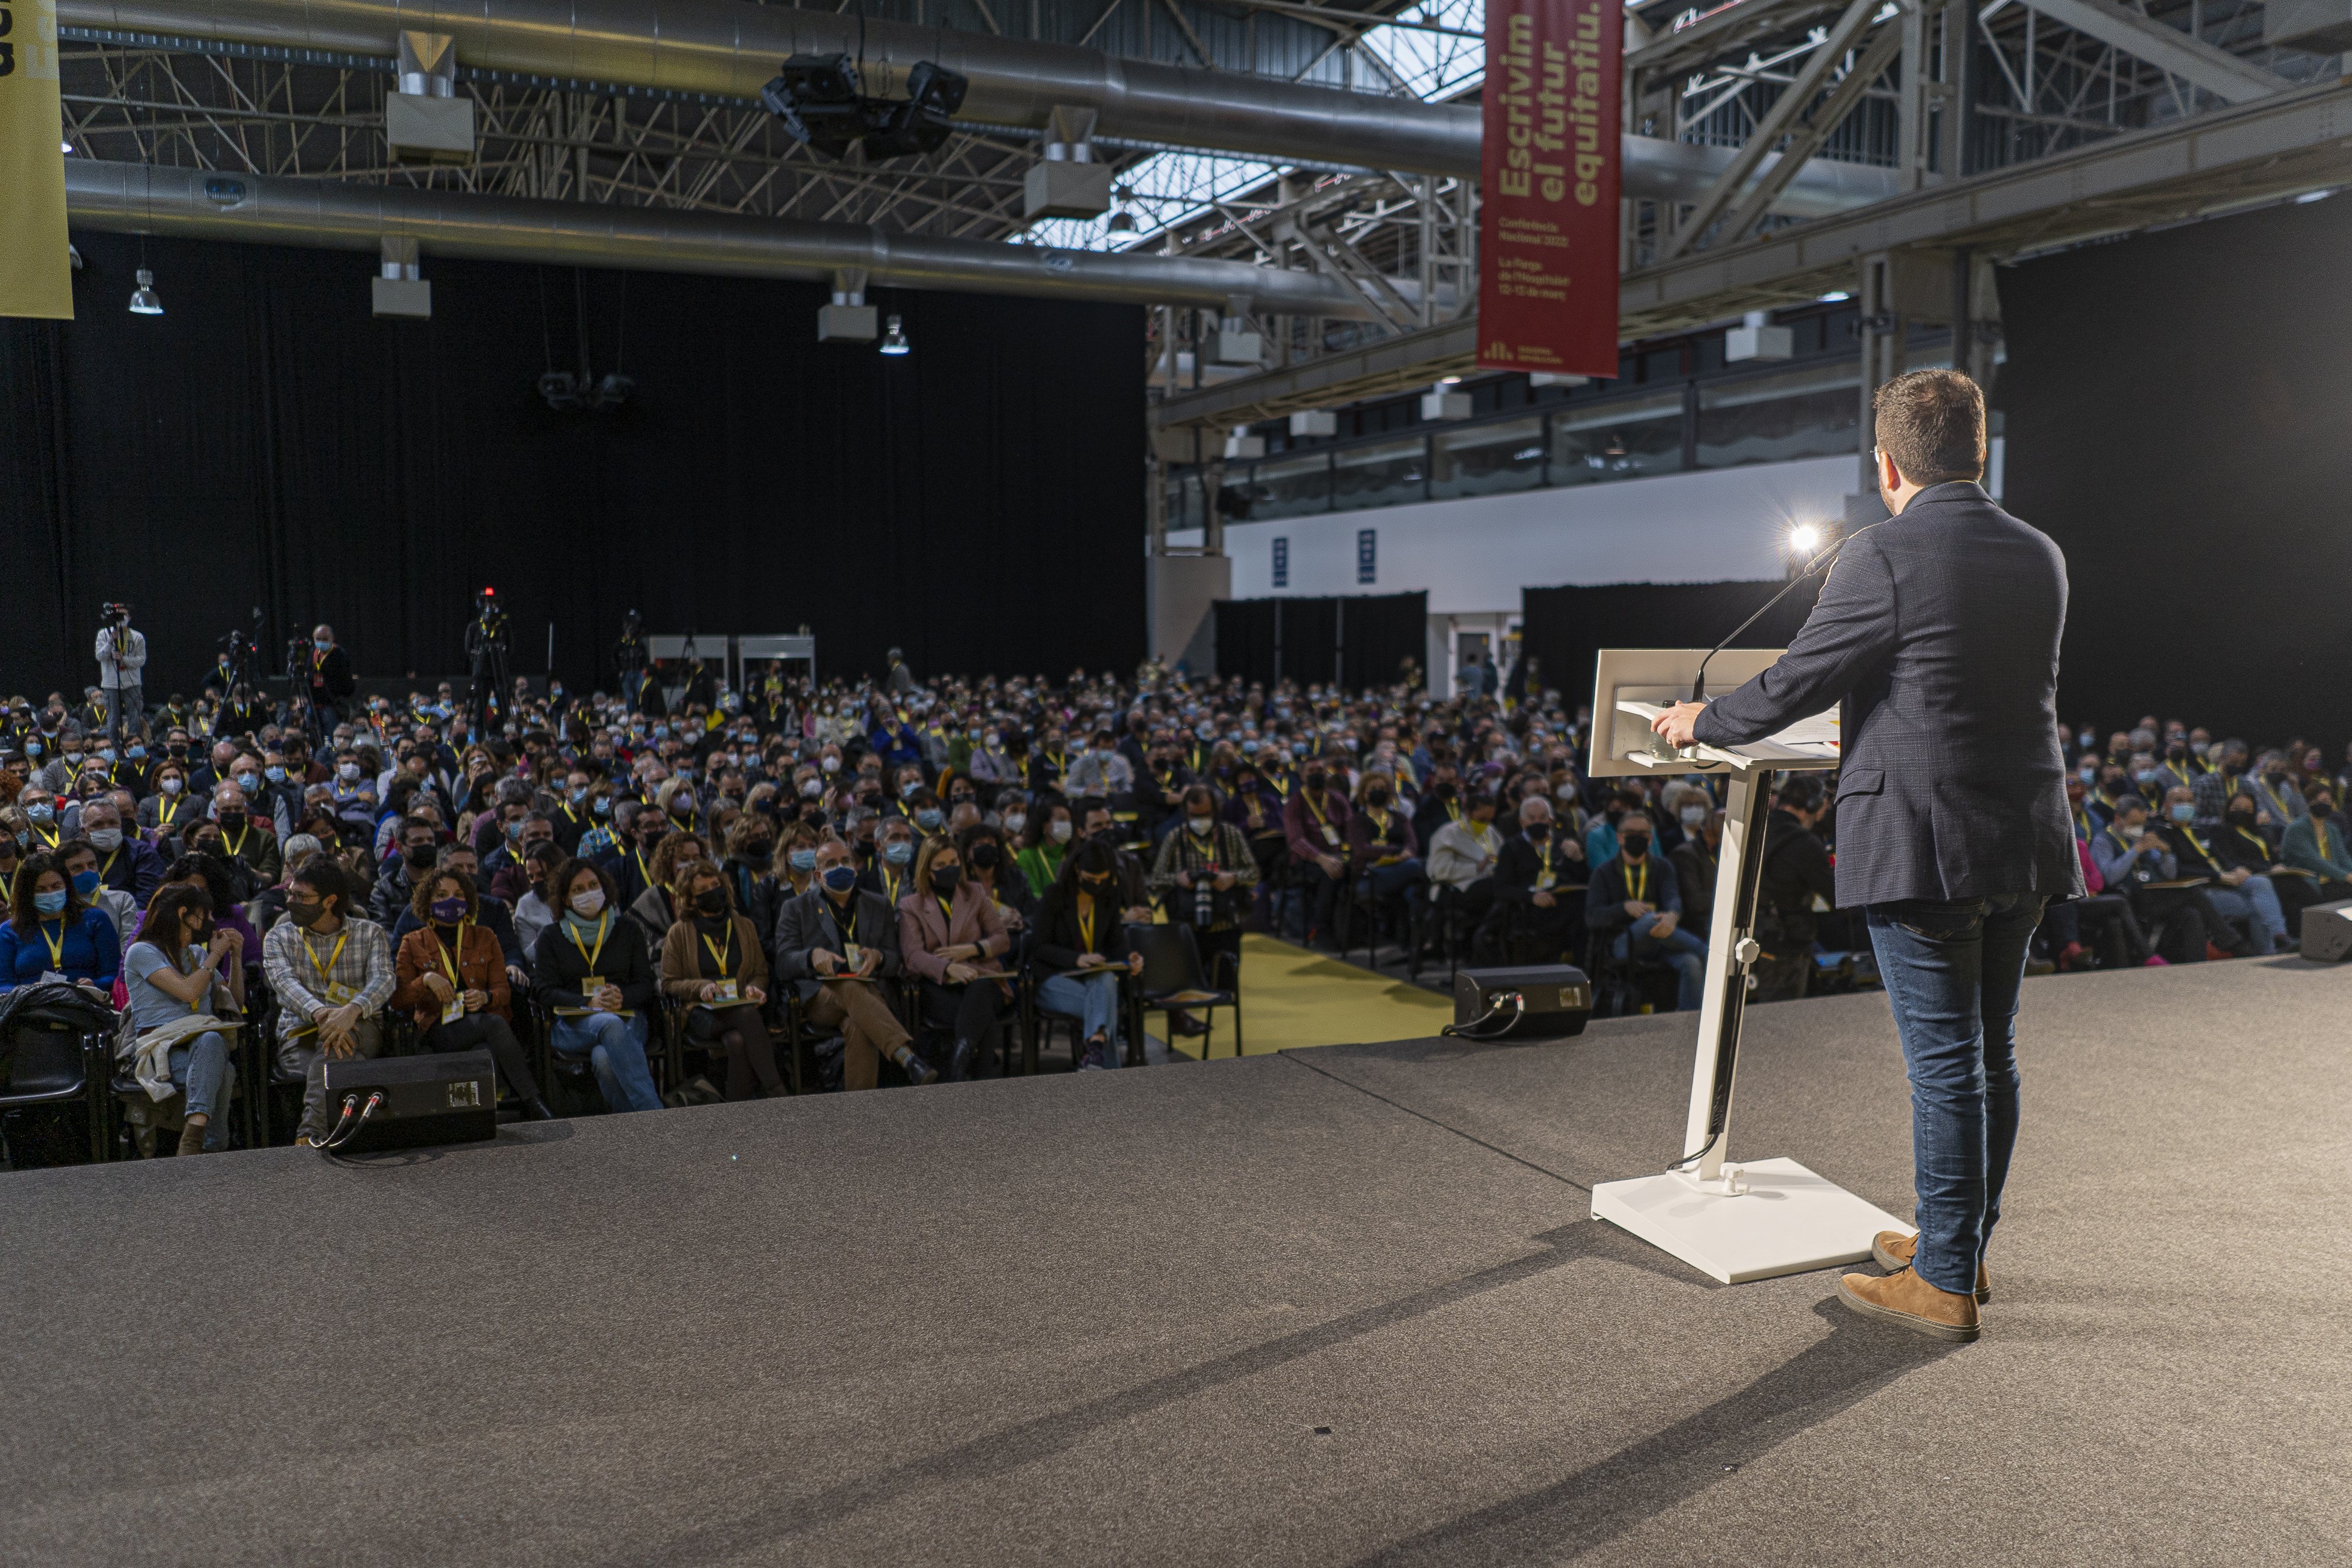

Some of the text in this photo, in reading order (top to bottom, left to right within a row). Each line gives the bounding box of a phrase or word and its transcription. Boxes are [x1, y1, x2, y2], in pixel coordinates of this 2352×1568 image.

[1499, 13, 1533, 197] Escrivim
[1533, 41, 1566, 202] el futur
[1568, 2, 1605, 206] equitatiu.
